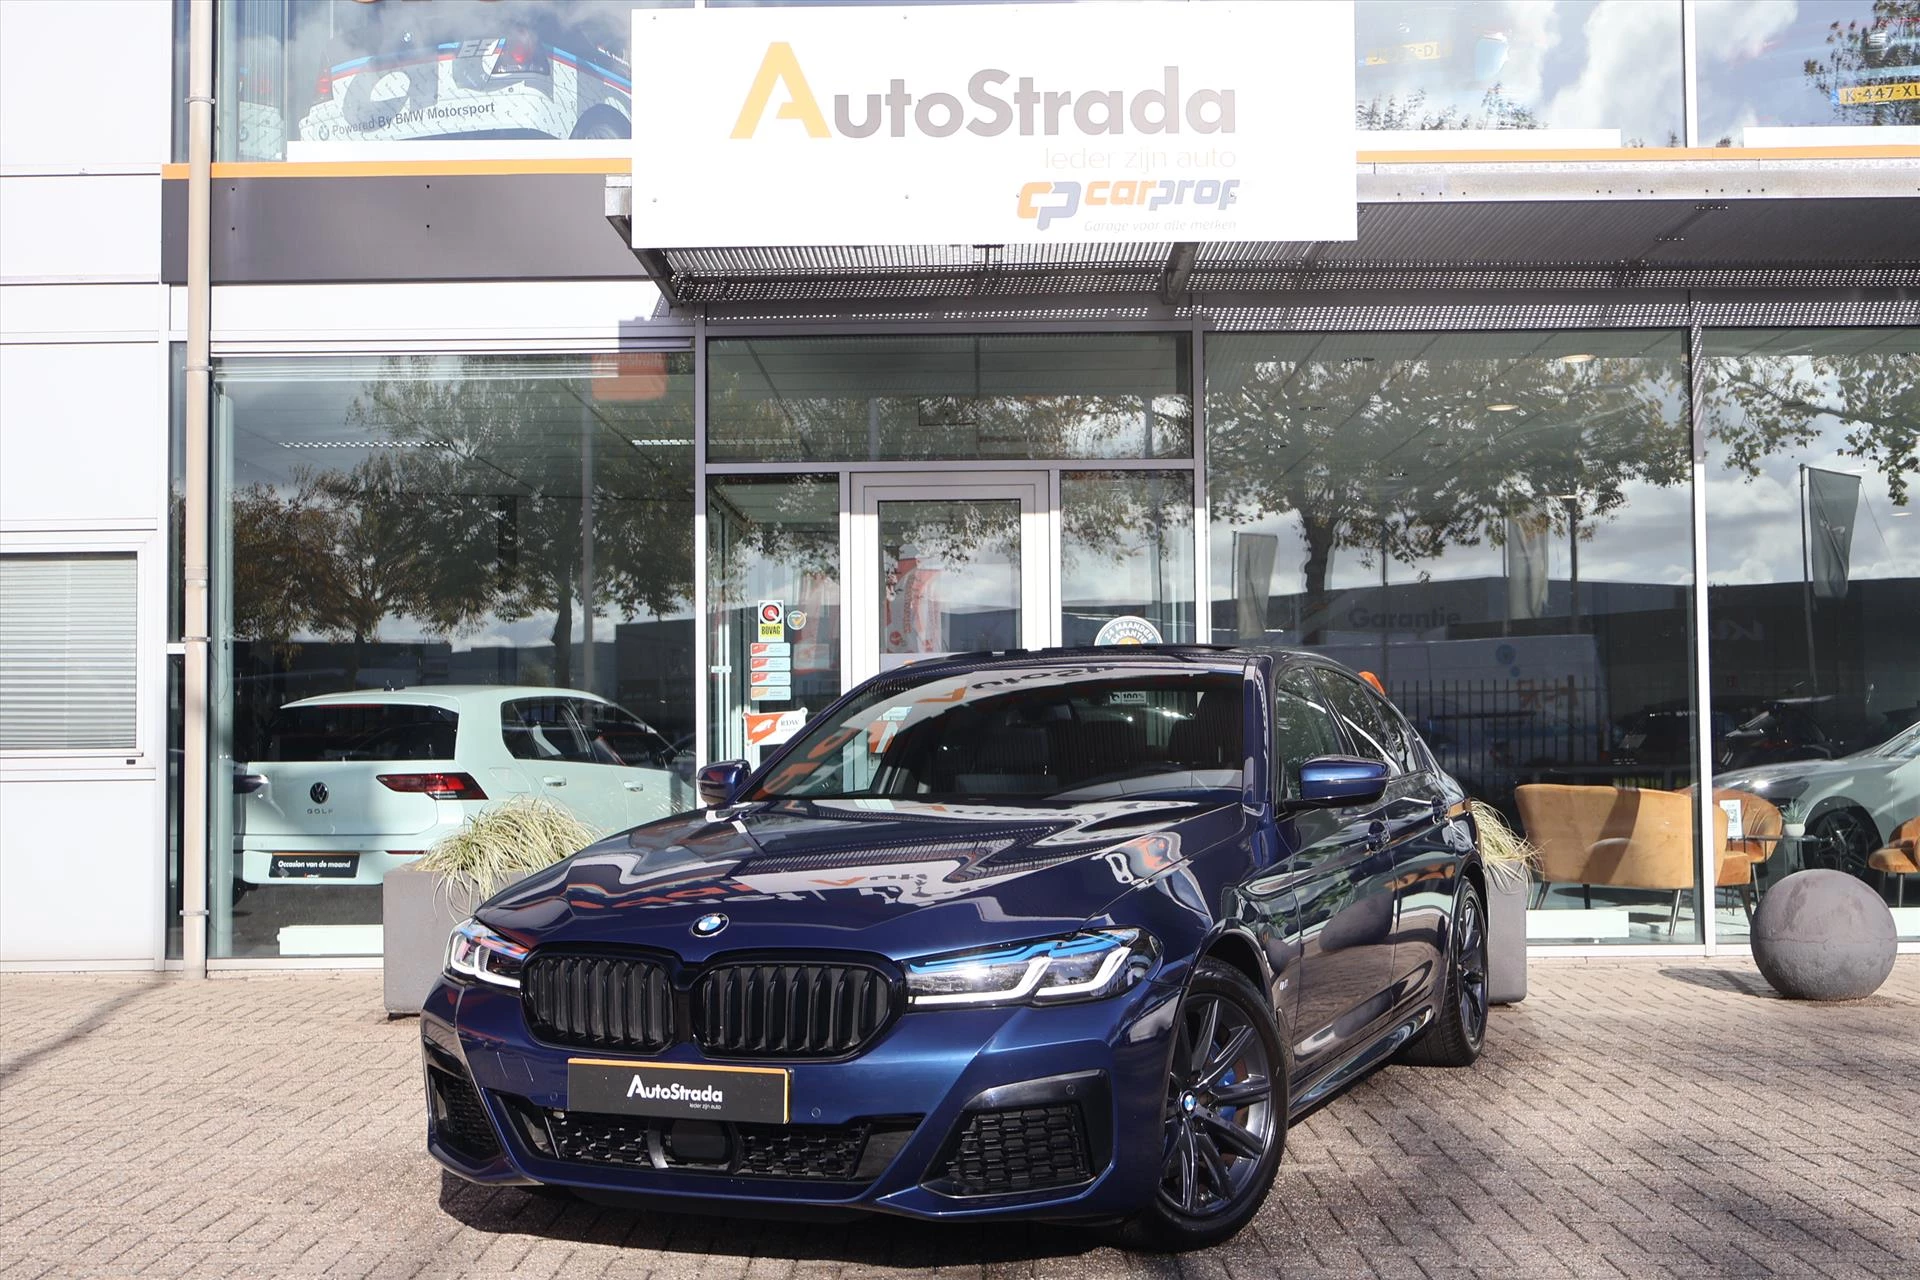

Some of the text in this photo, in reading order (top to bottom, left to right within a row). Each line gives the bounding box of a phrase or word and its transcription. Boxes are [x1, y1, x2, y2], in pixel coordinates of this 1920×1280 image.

[729, 41, 1235, 139] AutoStrada
[332, 102, 496, 136] Powered By BMW Motorsport
[1044, 147, 1236, 175] Ieder zijn auto
[1084, 219, 1237, 233] Garage voor alle merken
[1348, 606, 1461, 628] Garantie
[1115, 621, 1154, 641] MAANDEN
[278, 860, 305, 868] Occasion
[319, 860, 327, 868] de
[328, 860, 351, 868] maand
[626, 1074, 723, 1103] AutoStrada
